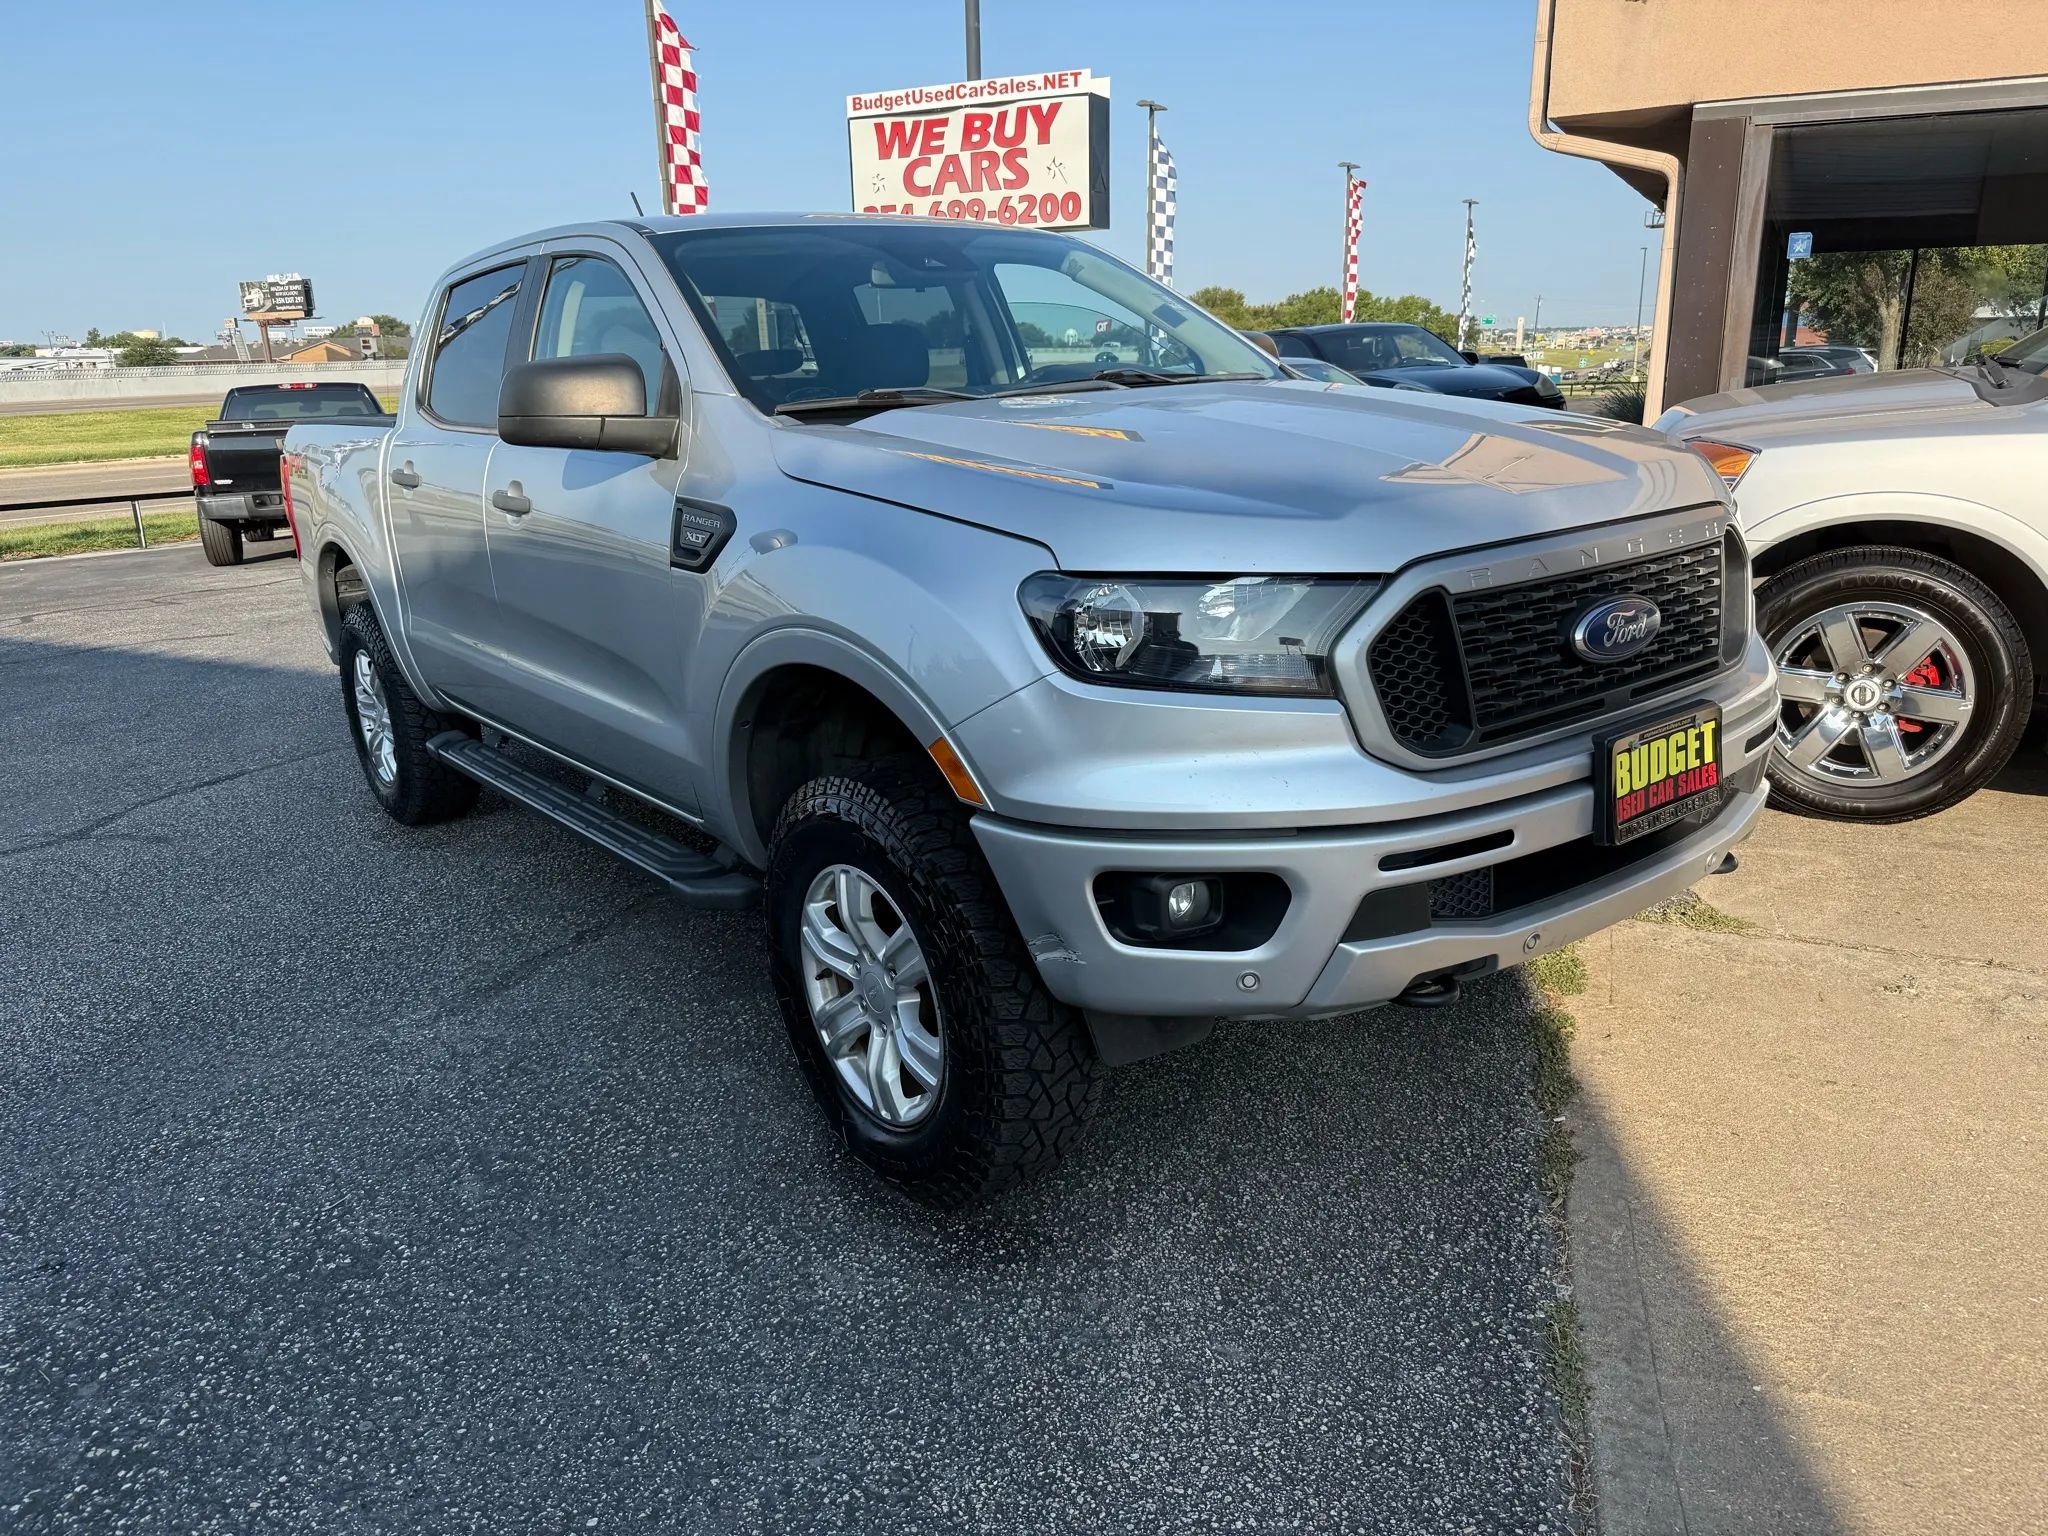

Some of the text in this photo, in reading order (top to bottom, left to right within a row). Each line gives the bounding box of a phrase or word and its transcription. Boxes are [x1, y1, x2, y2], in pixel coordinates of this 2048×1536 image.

[852, 71, 1082, 111] BudgetUsedCarSales.NET
[874, 102, 1063, 160] WE BUY
[903, 148, 1029, 197] CARS
[683, 513, 720, 528] RANGER
[686, 532, 705, 543] XLT
[1467, 521, 1719, 588] RANGER
[1604, 609, 1648, 647] Ford
[1616, 720, 1716, 799] BUDGET
[1649, 778, 1674, 808] CAR
[1678, 762, 1717, 795] SALES
